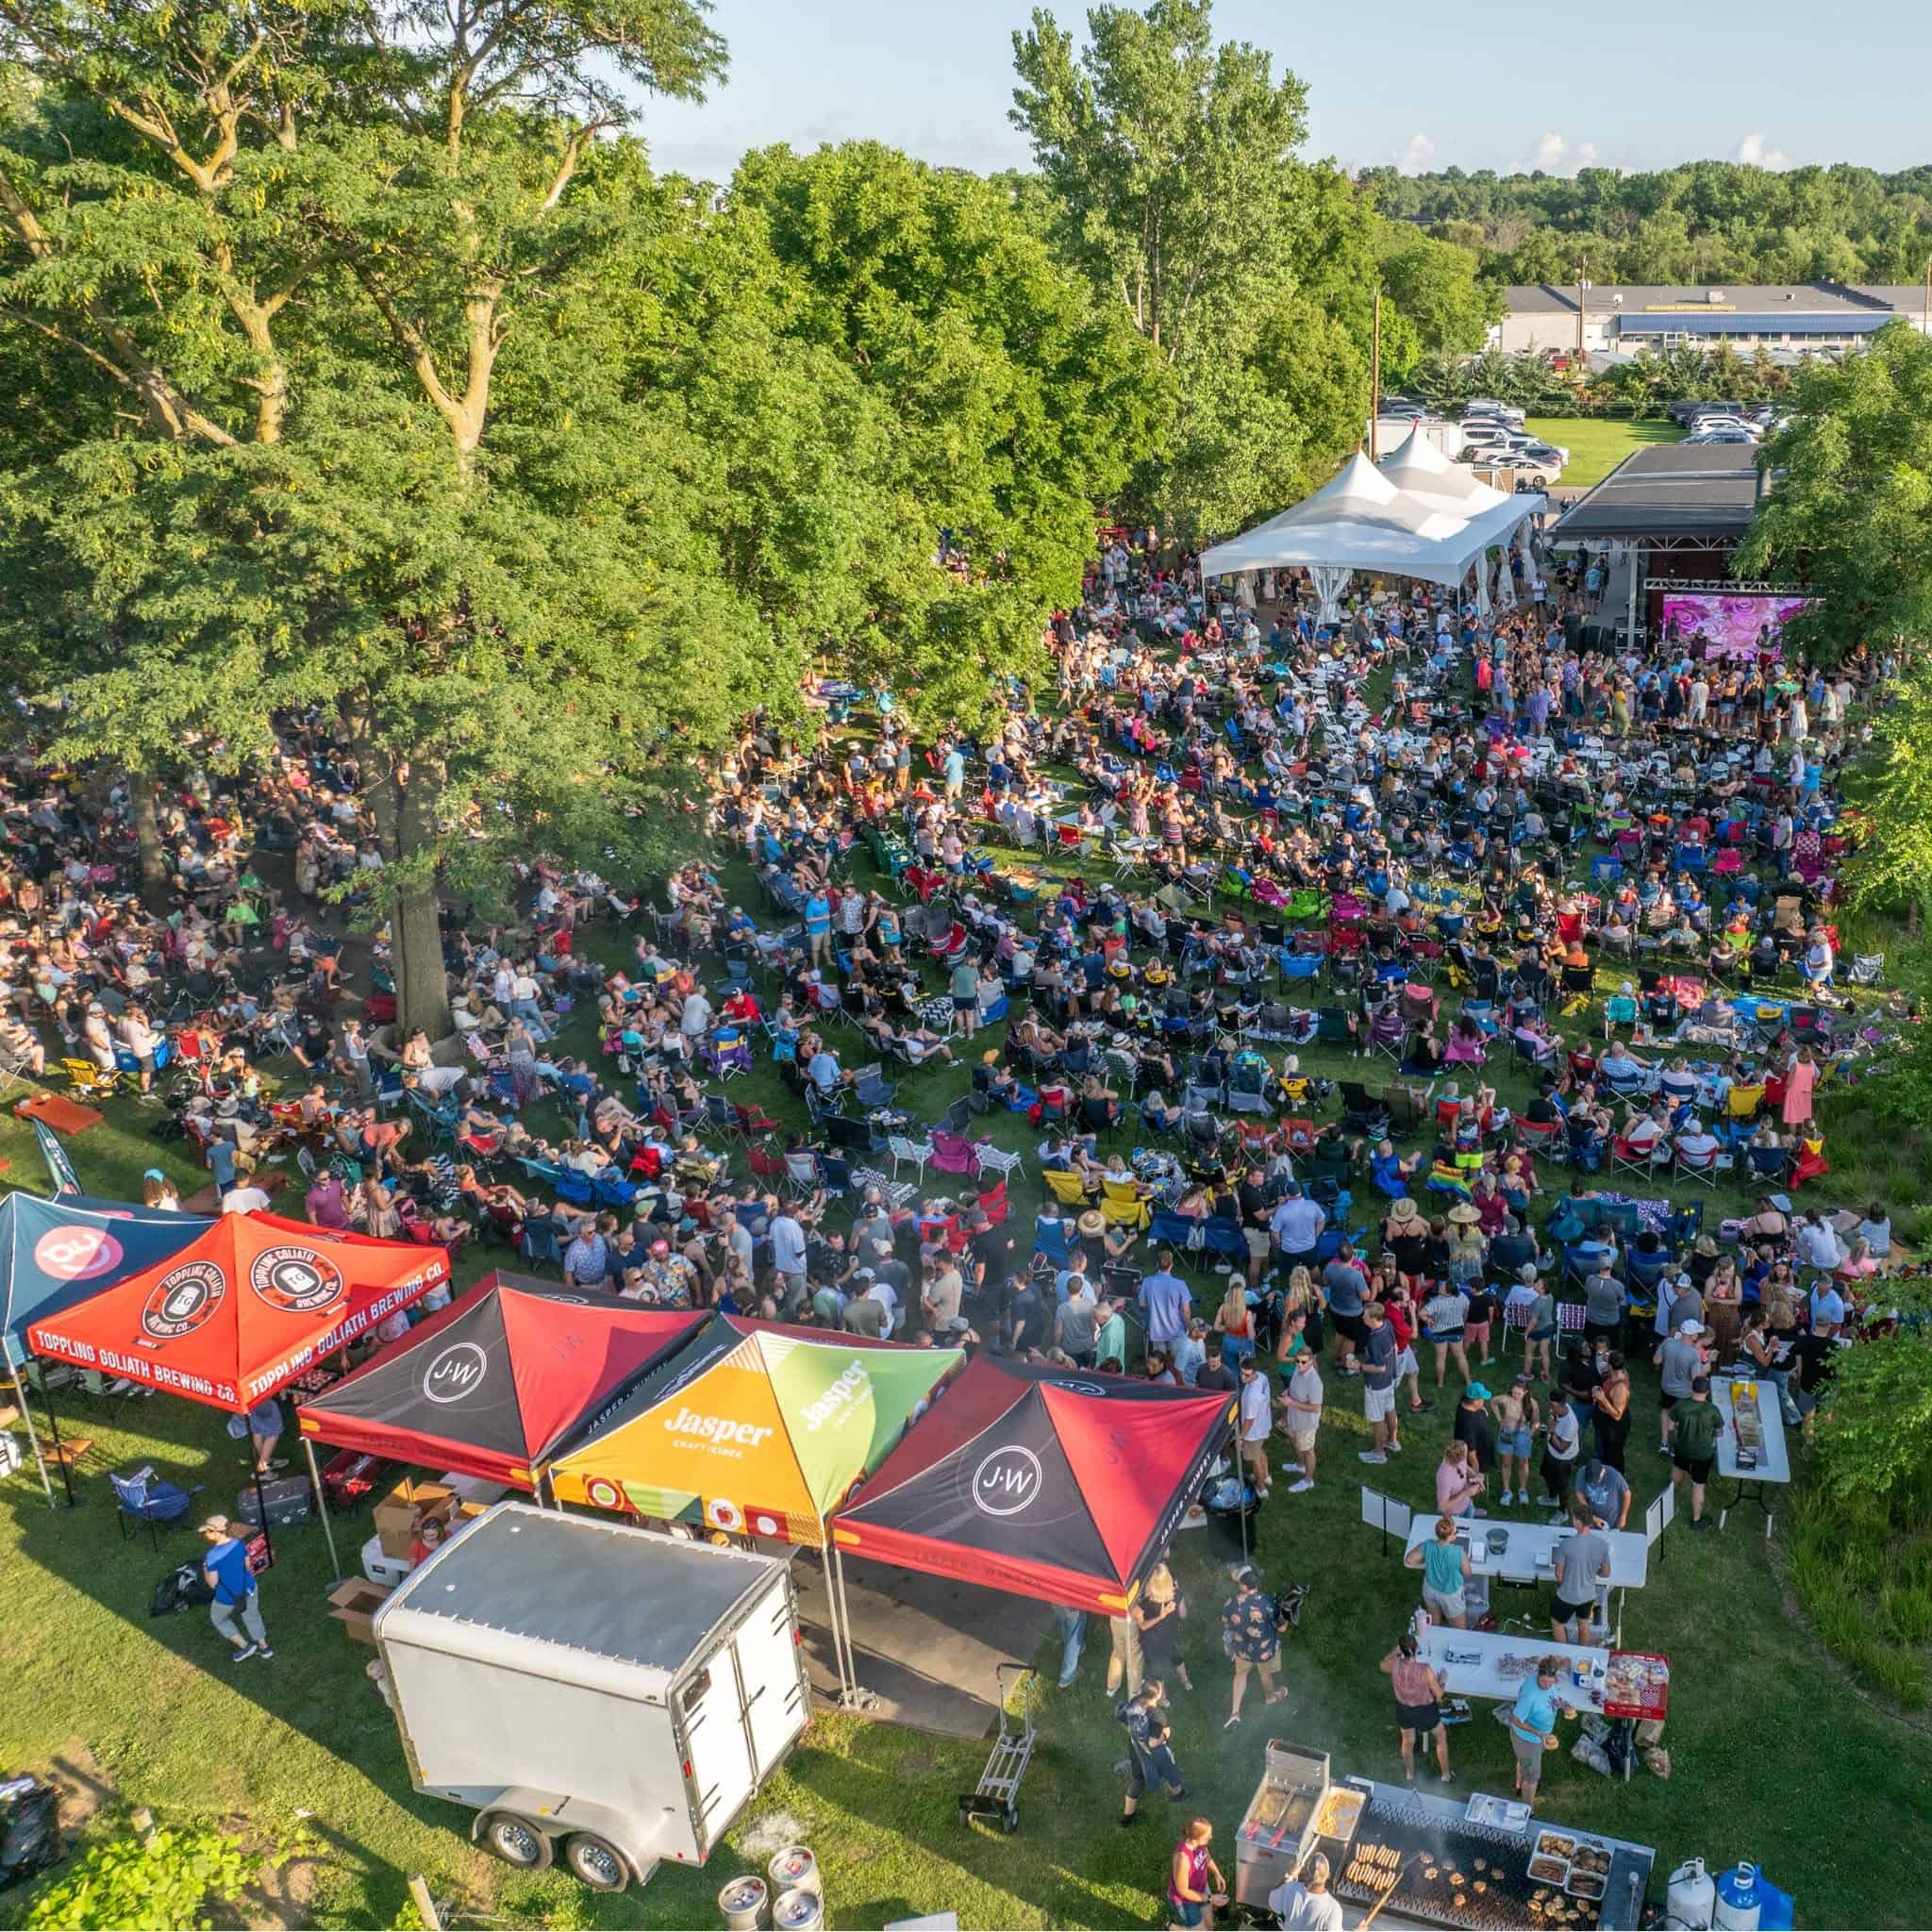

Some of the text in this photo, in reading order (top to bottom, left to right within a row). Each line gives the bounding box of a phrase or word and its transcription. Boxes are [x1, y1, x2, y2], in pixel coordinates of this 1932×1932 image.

[164, 1265, 206, 1289] TOPPLING
[256, 1249, 316, 1289] TOPPLING GOLIATH
[249, 1261, 446, 1398] TOPPLING GOLIATH BREWING CO.
[36, 1330, 240, 1405] TOPPLING GOLIATH BREWING CO.
[589, 1397, 625, 1434] JASPER
[664, 1407, 774, 1446] Jasper
